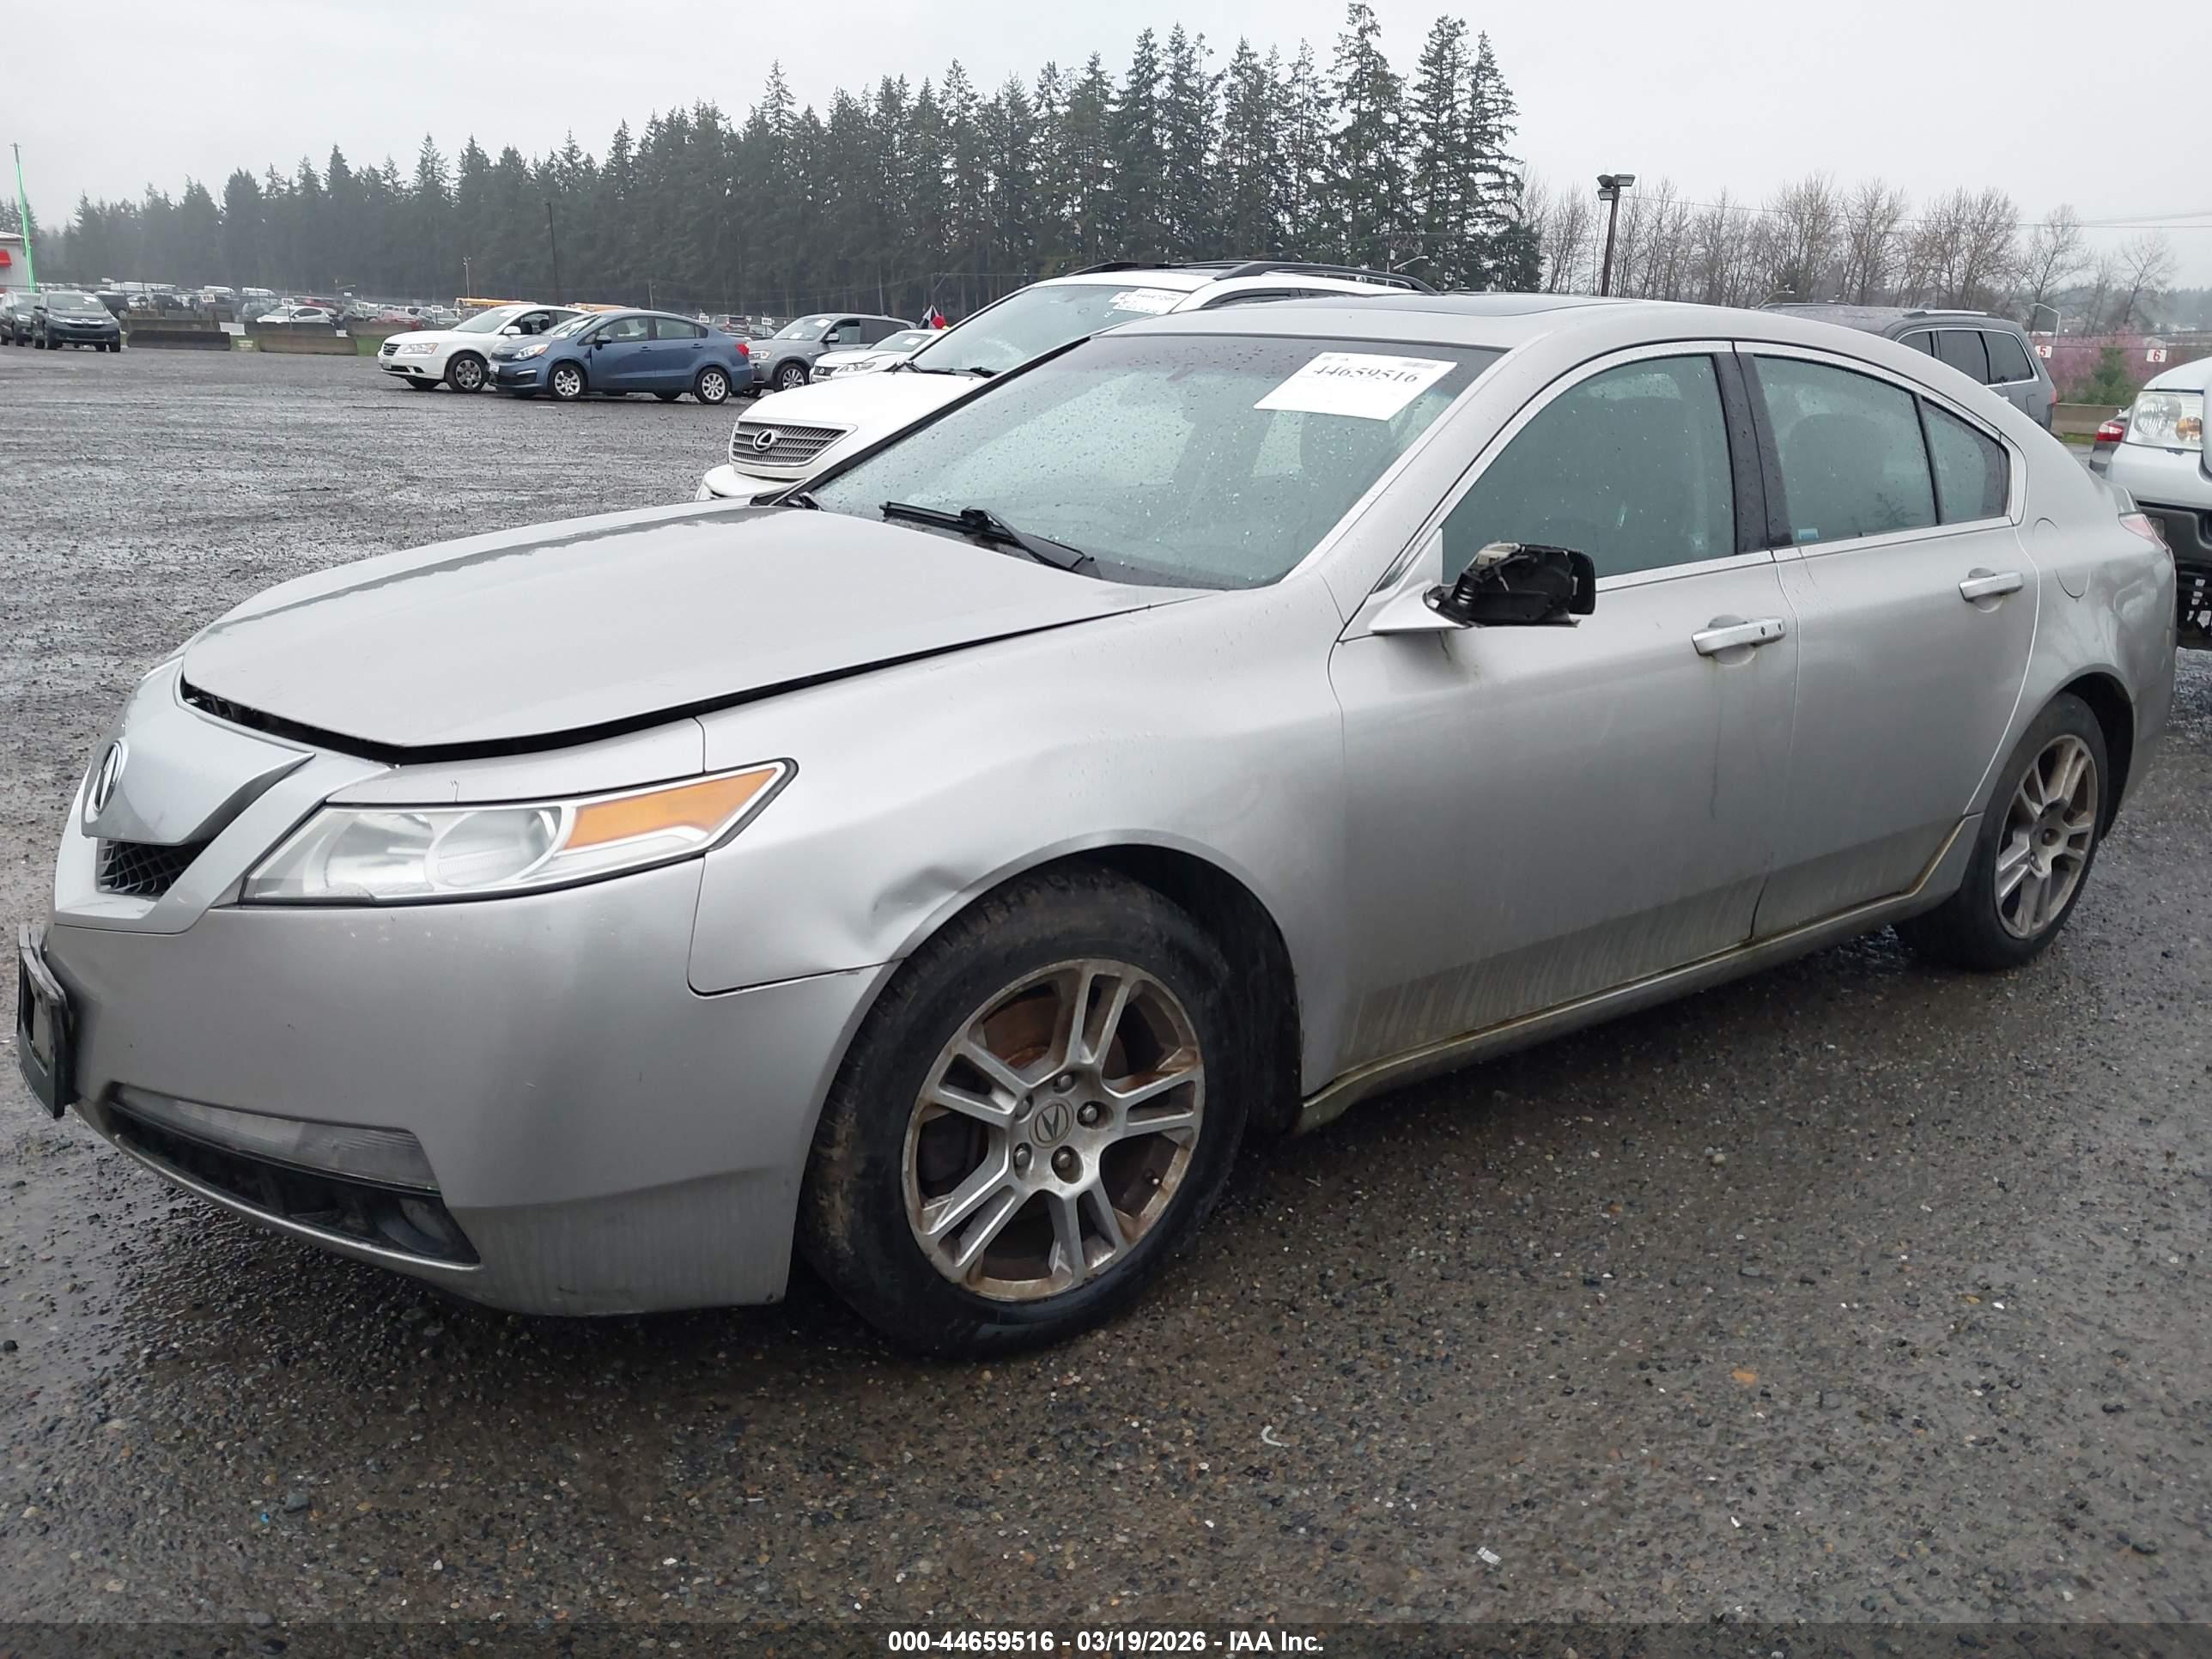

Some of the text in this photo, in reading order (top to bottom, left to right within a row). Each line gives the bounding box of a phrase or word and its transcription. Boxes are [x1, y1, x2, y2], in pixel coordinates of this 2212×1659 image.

[2039, 346, 2047, 357] 5
[2153, 349, 2160, 362] 6
[1313, 365, 1421, 383] 44659516
